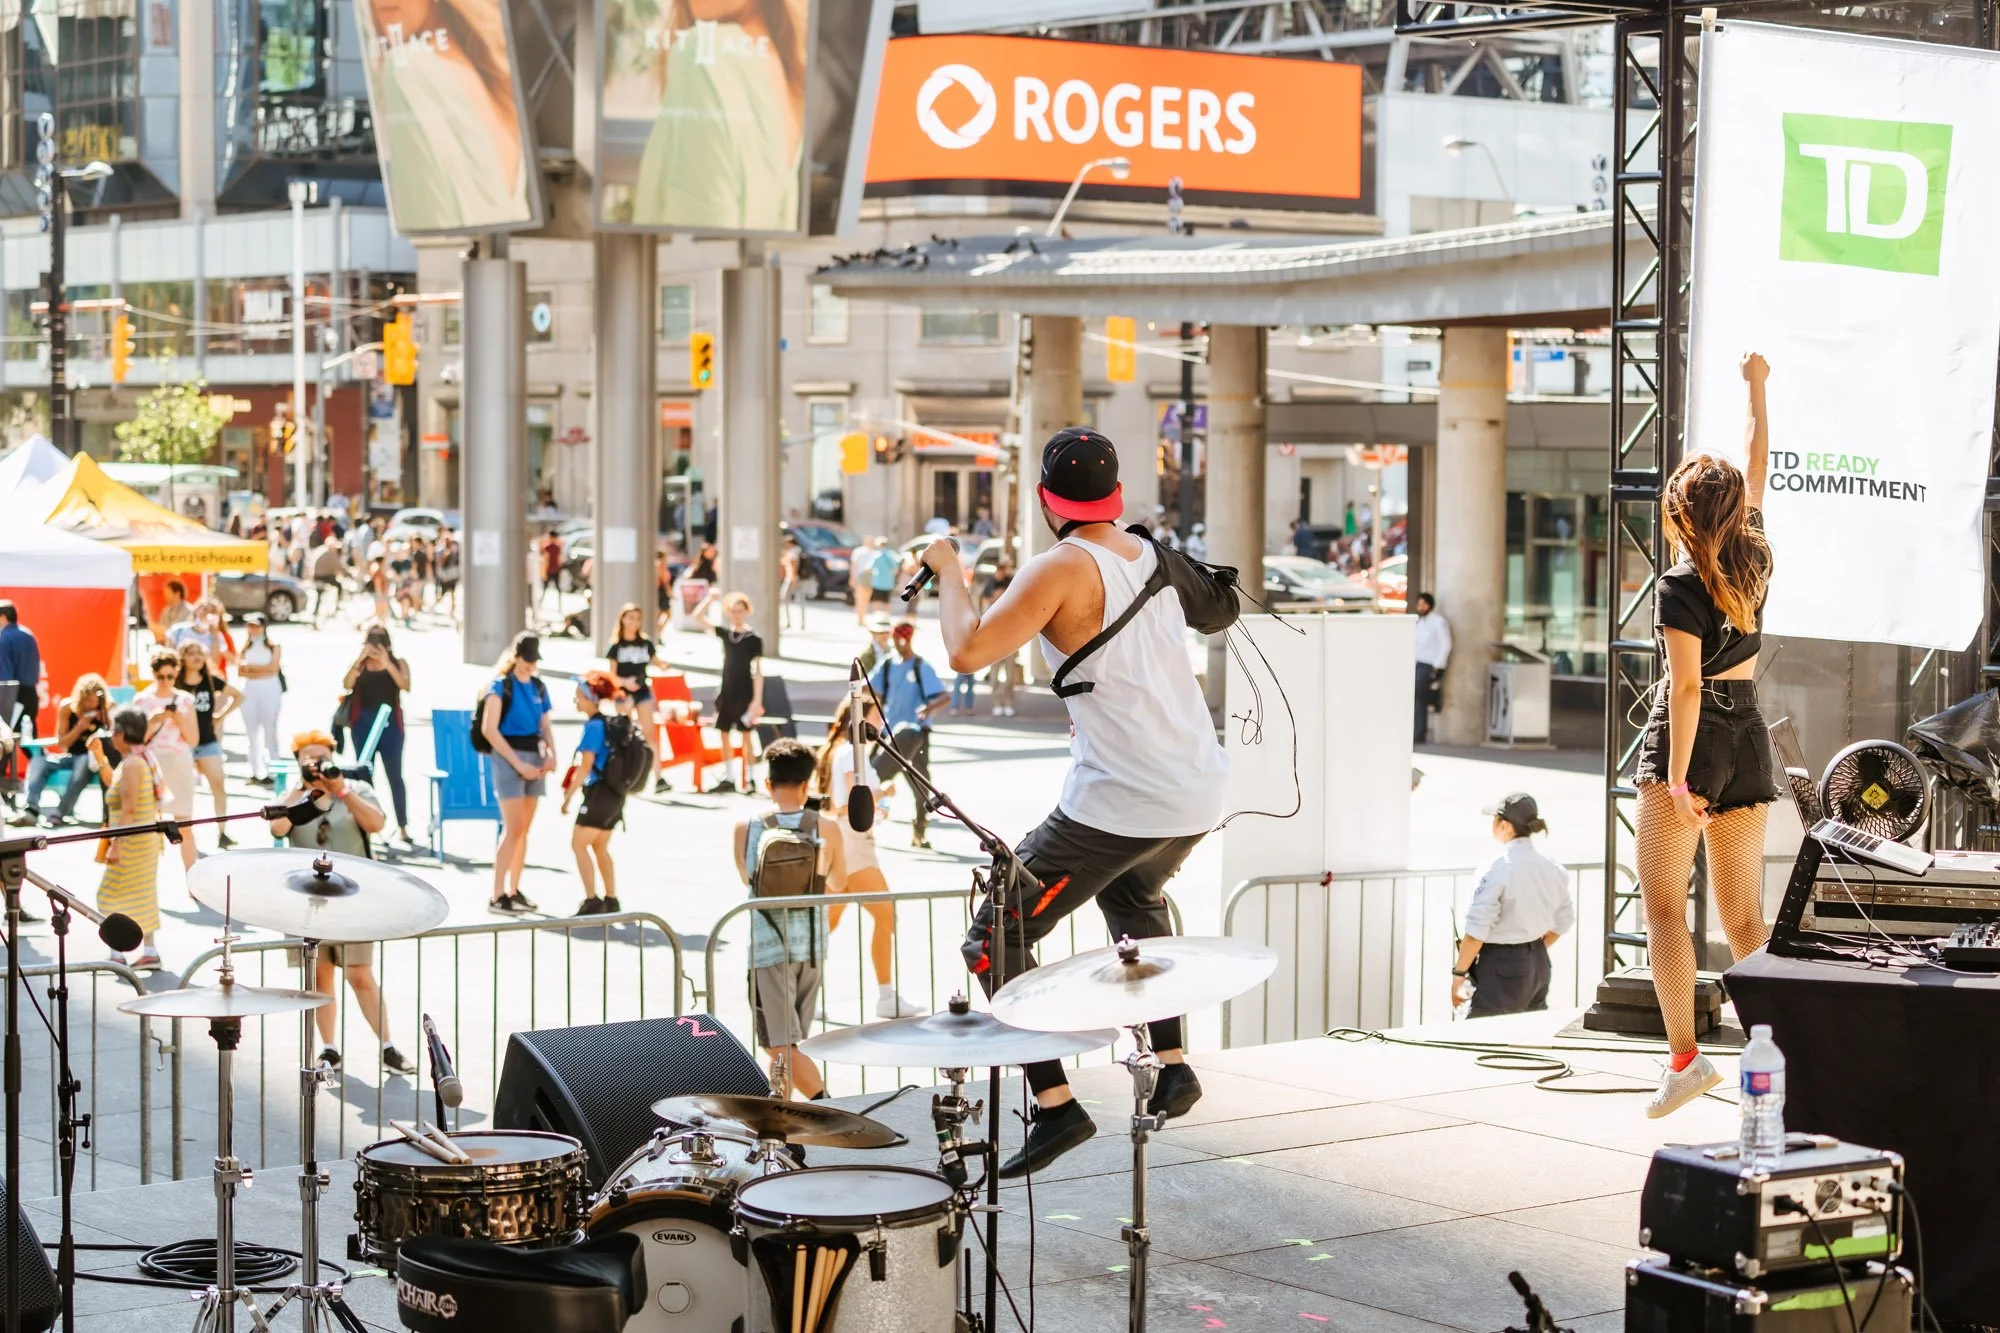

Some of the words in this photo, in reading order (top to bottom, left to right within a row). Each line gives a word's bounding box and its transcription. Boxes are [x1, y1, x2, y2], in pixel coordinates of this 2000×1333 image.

[408, 27, 449, 52] ACE
[644, 28, 689, 50] KIT
[722, 35, 769, 57] ACE
[1013, 75, 1257, 155] ROGERS
[1798, 142, 1929, 240] TD
[1769, 450, 1801, 470] TD
[1805, 451, 1880, 476] READY
[1769, 472, 1927, 503] COMMITMENT
[657, 1233, 691, 1242] EVANS
